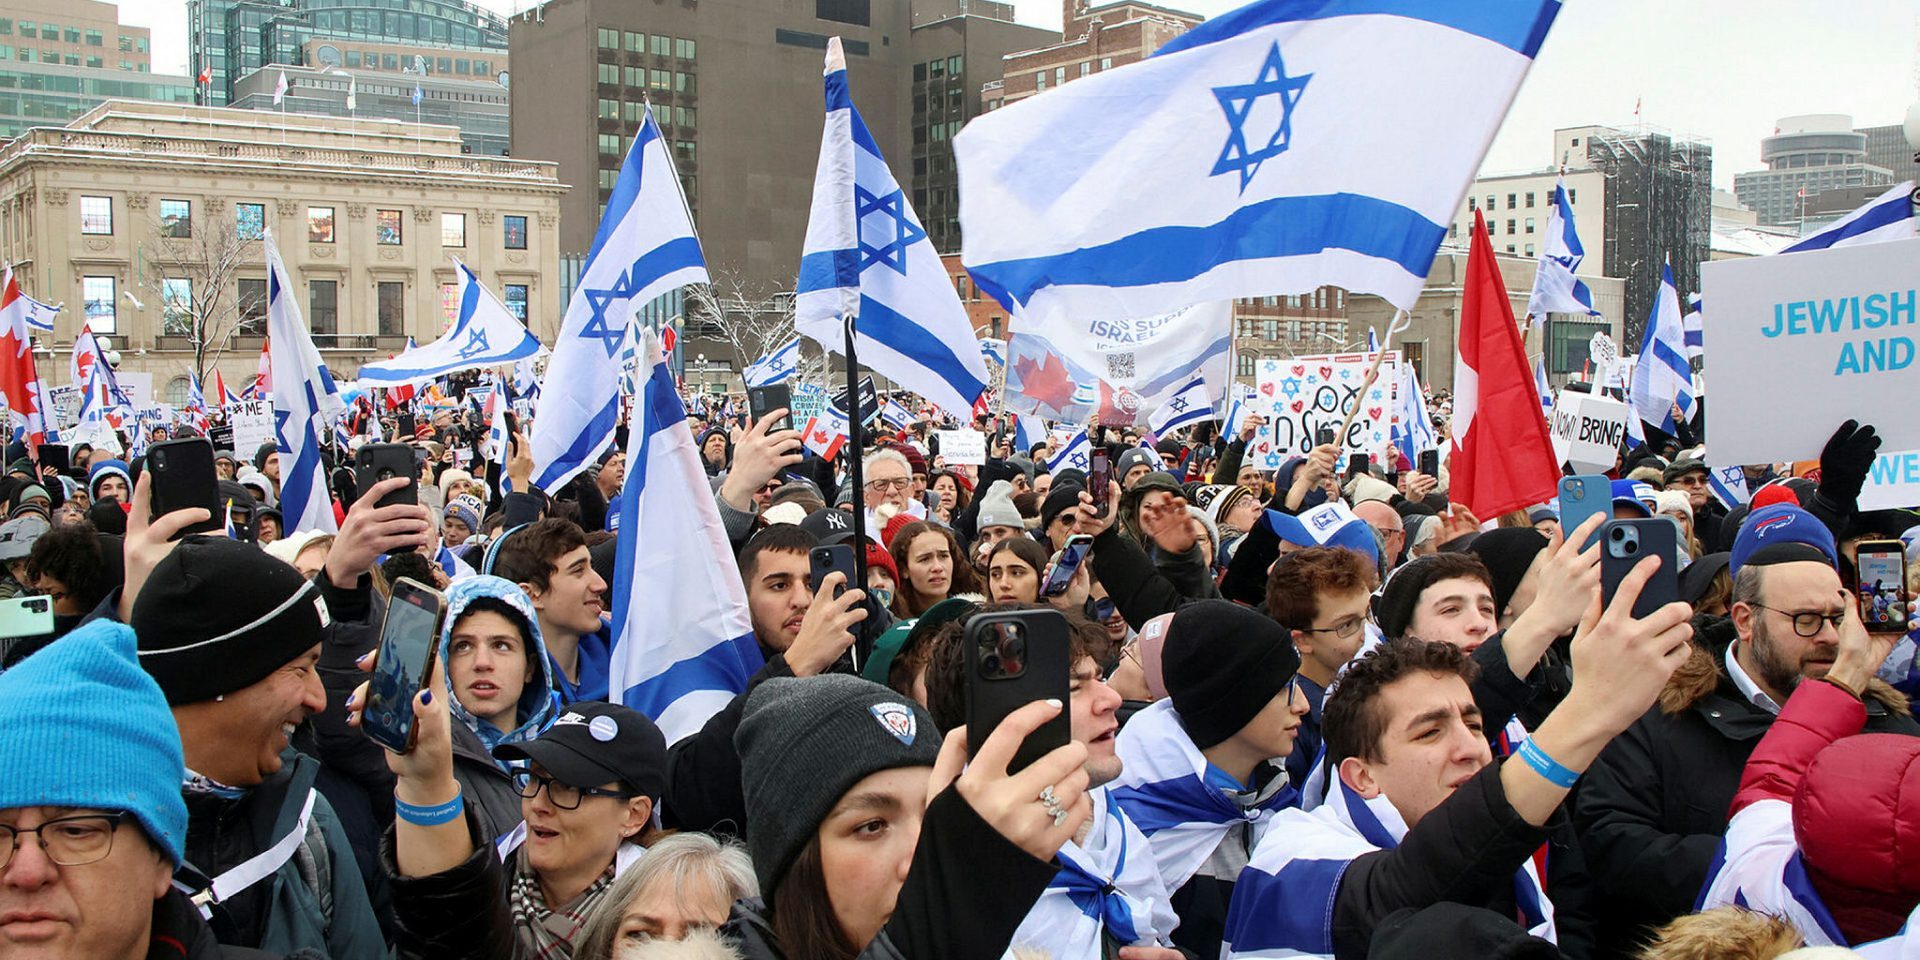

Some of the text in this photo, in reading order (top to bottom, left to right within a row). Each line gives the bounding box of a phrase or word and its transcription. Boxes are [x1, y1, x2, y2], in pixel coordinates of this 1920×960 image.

[1761, 290, 1916, 338] JEWISH
[1834, 338, 1916, 376] AND
[1579, 416, 1622, 449] BRING
[1870, 454, 1919, 485] WE
